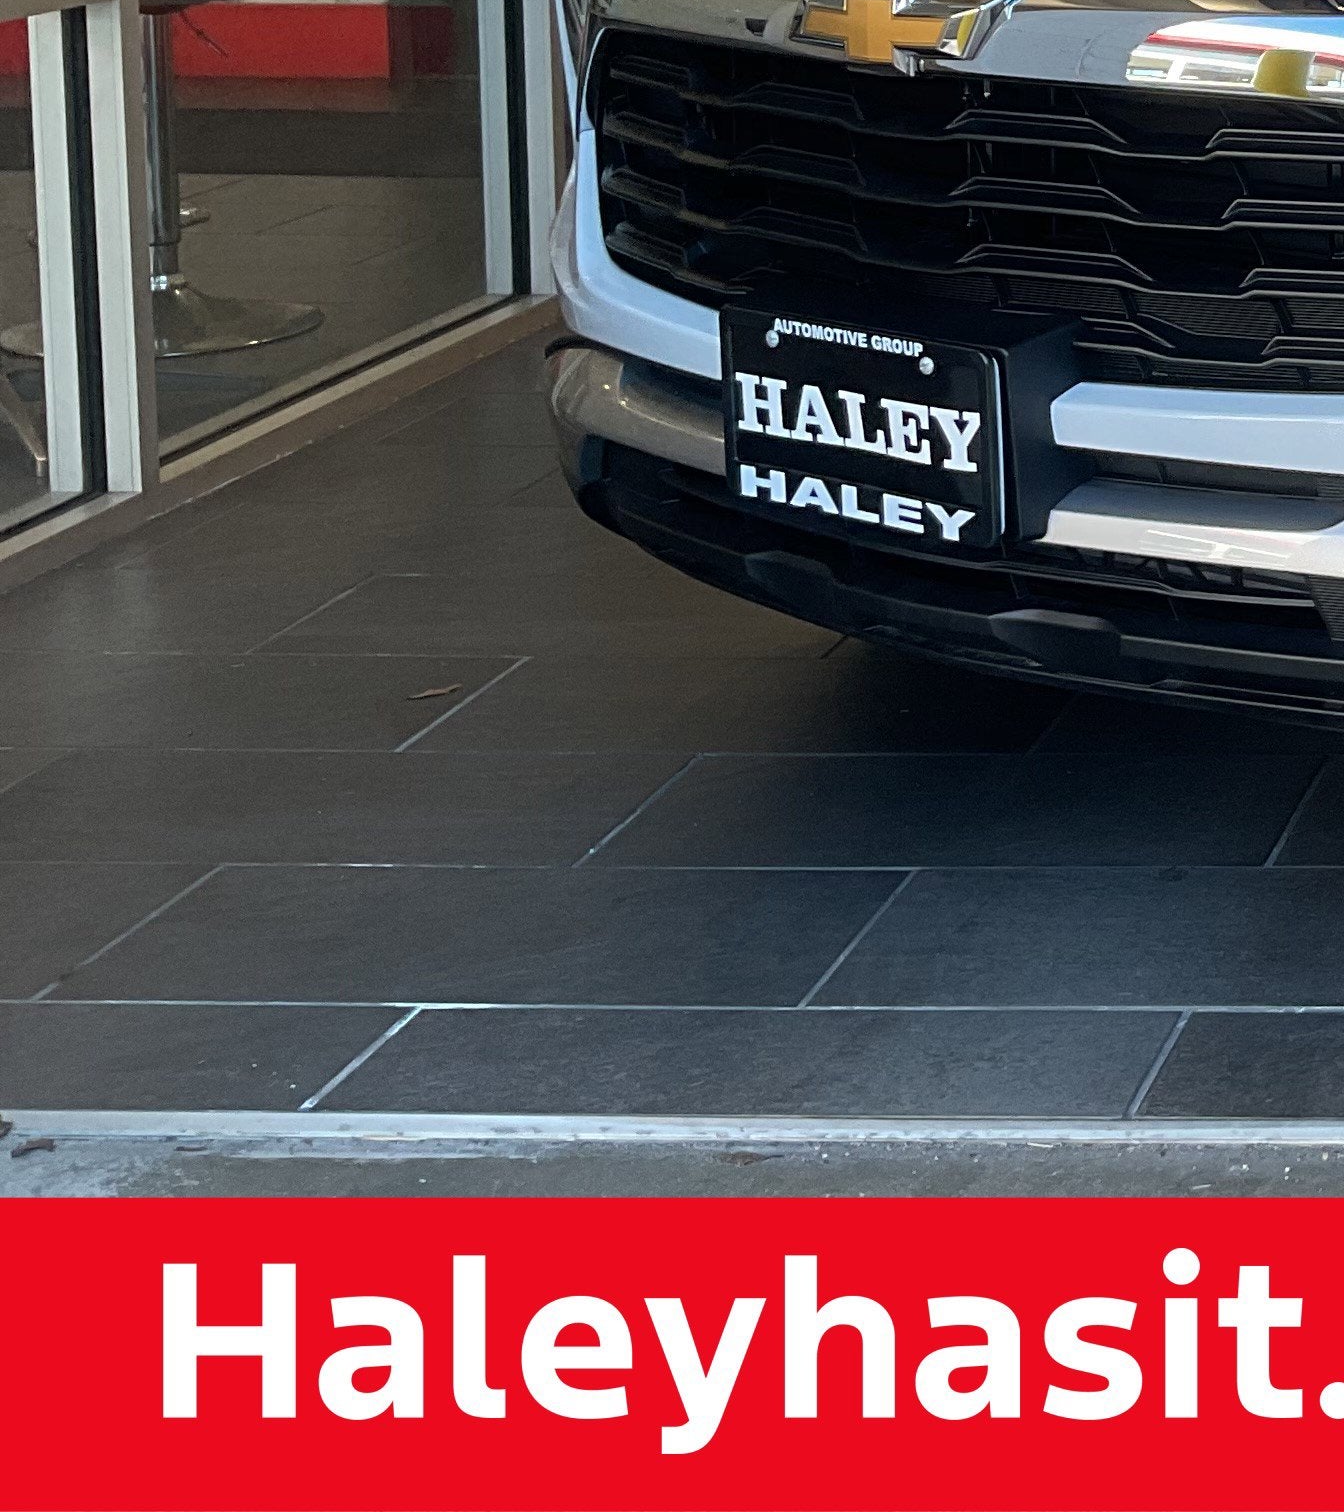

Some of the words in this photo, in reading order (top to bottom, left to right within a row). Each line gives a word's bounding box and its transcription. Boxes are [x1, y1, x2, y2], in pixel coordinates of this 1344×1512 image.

[773, 318, 868, 349] AUTOMOTIVE
[871, 335, 923, 357] GROUP
[735, 371, 981, 473] HALEY
[740, 464, 976, 542] HALEY
